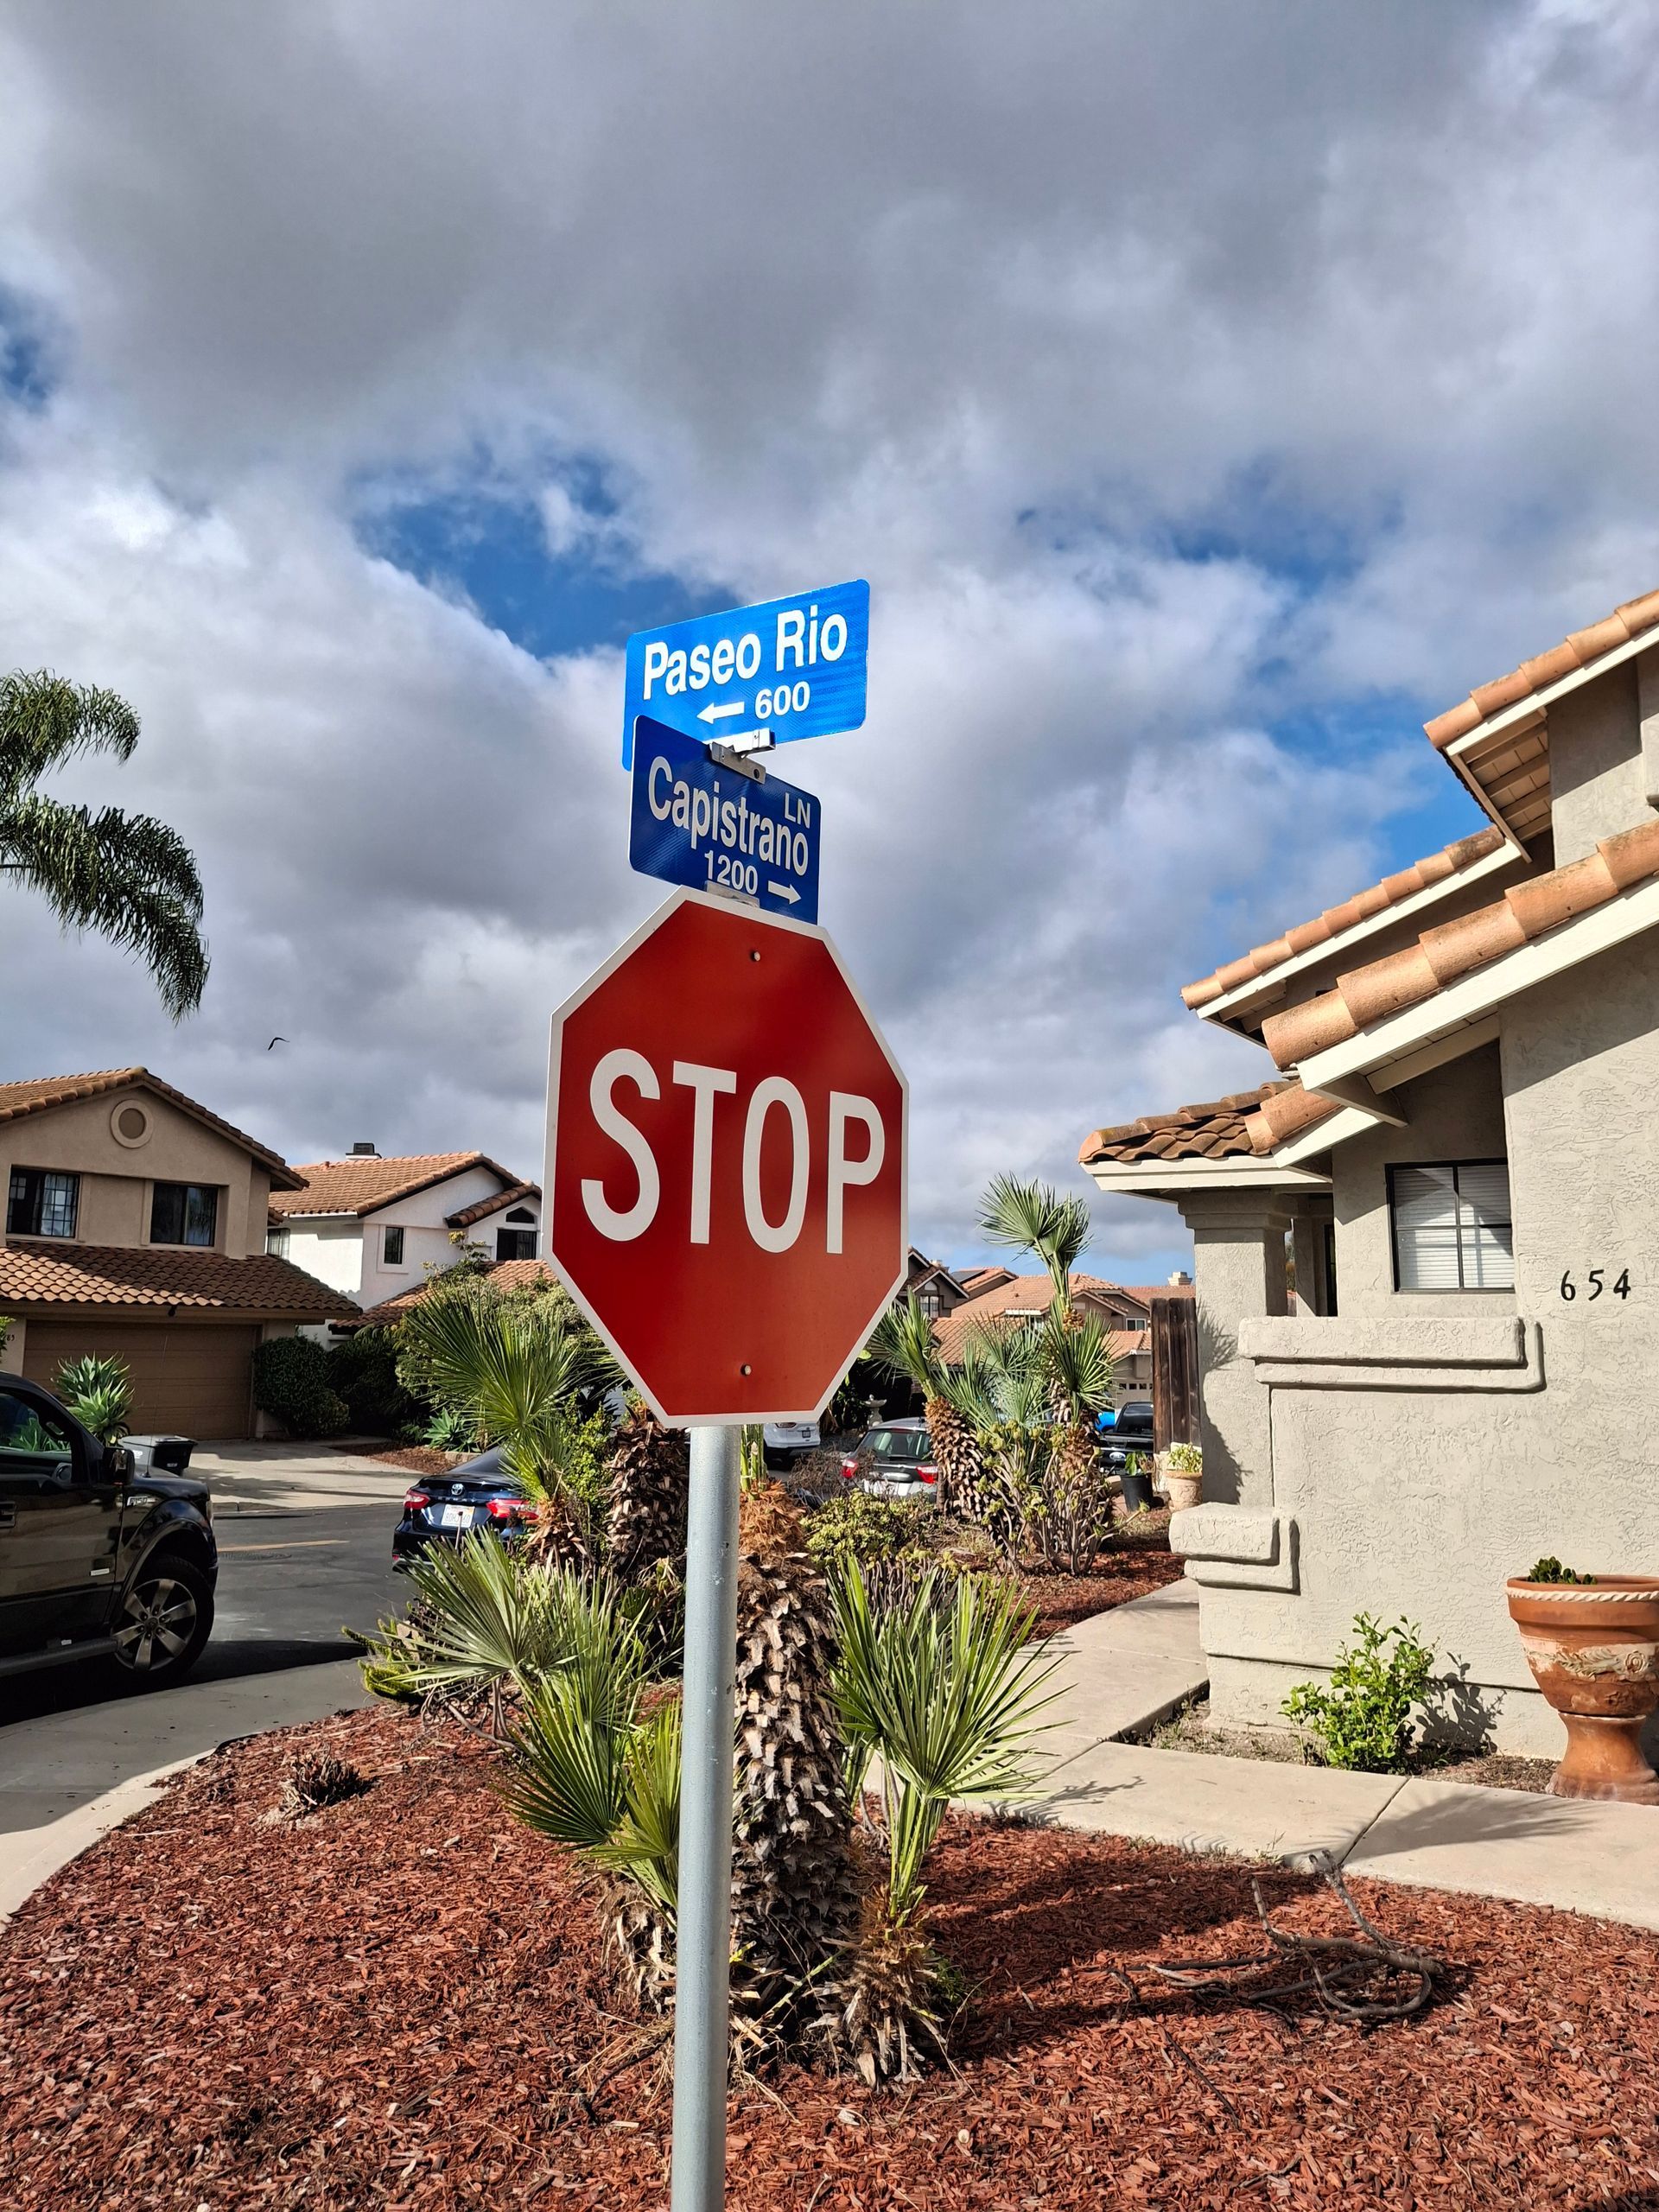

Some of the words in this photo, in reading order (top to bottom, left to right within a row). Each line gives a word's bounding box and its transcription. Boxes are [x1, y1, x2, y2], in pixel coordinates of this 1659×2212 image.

[643, 632, 761, 701] Paseo
[776, 604, 848, 672] Rio
[754, 681, 810, 720] 600
[648, 756, 809, 877] Capistrano
[785, 792, 810, 830] LN
[704, 849, 759, 895] 1200
[581, 1048, 886, 1254] STOP
[1560, 1268, 1630, 1301] 654
